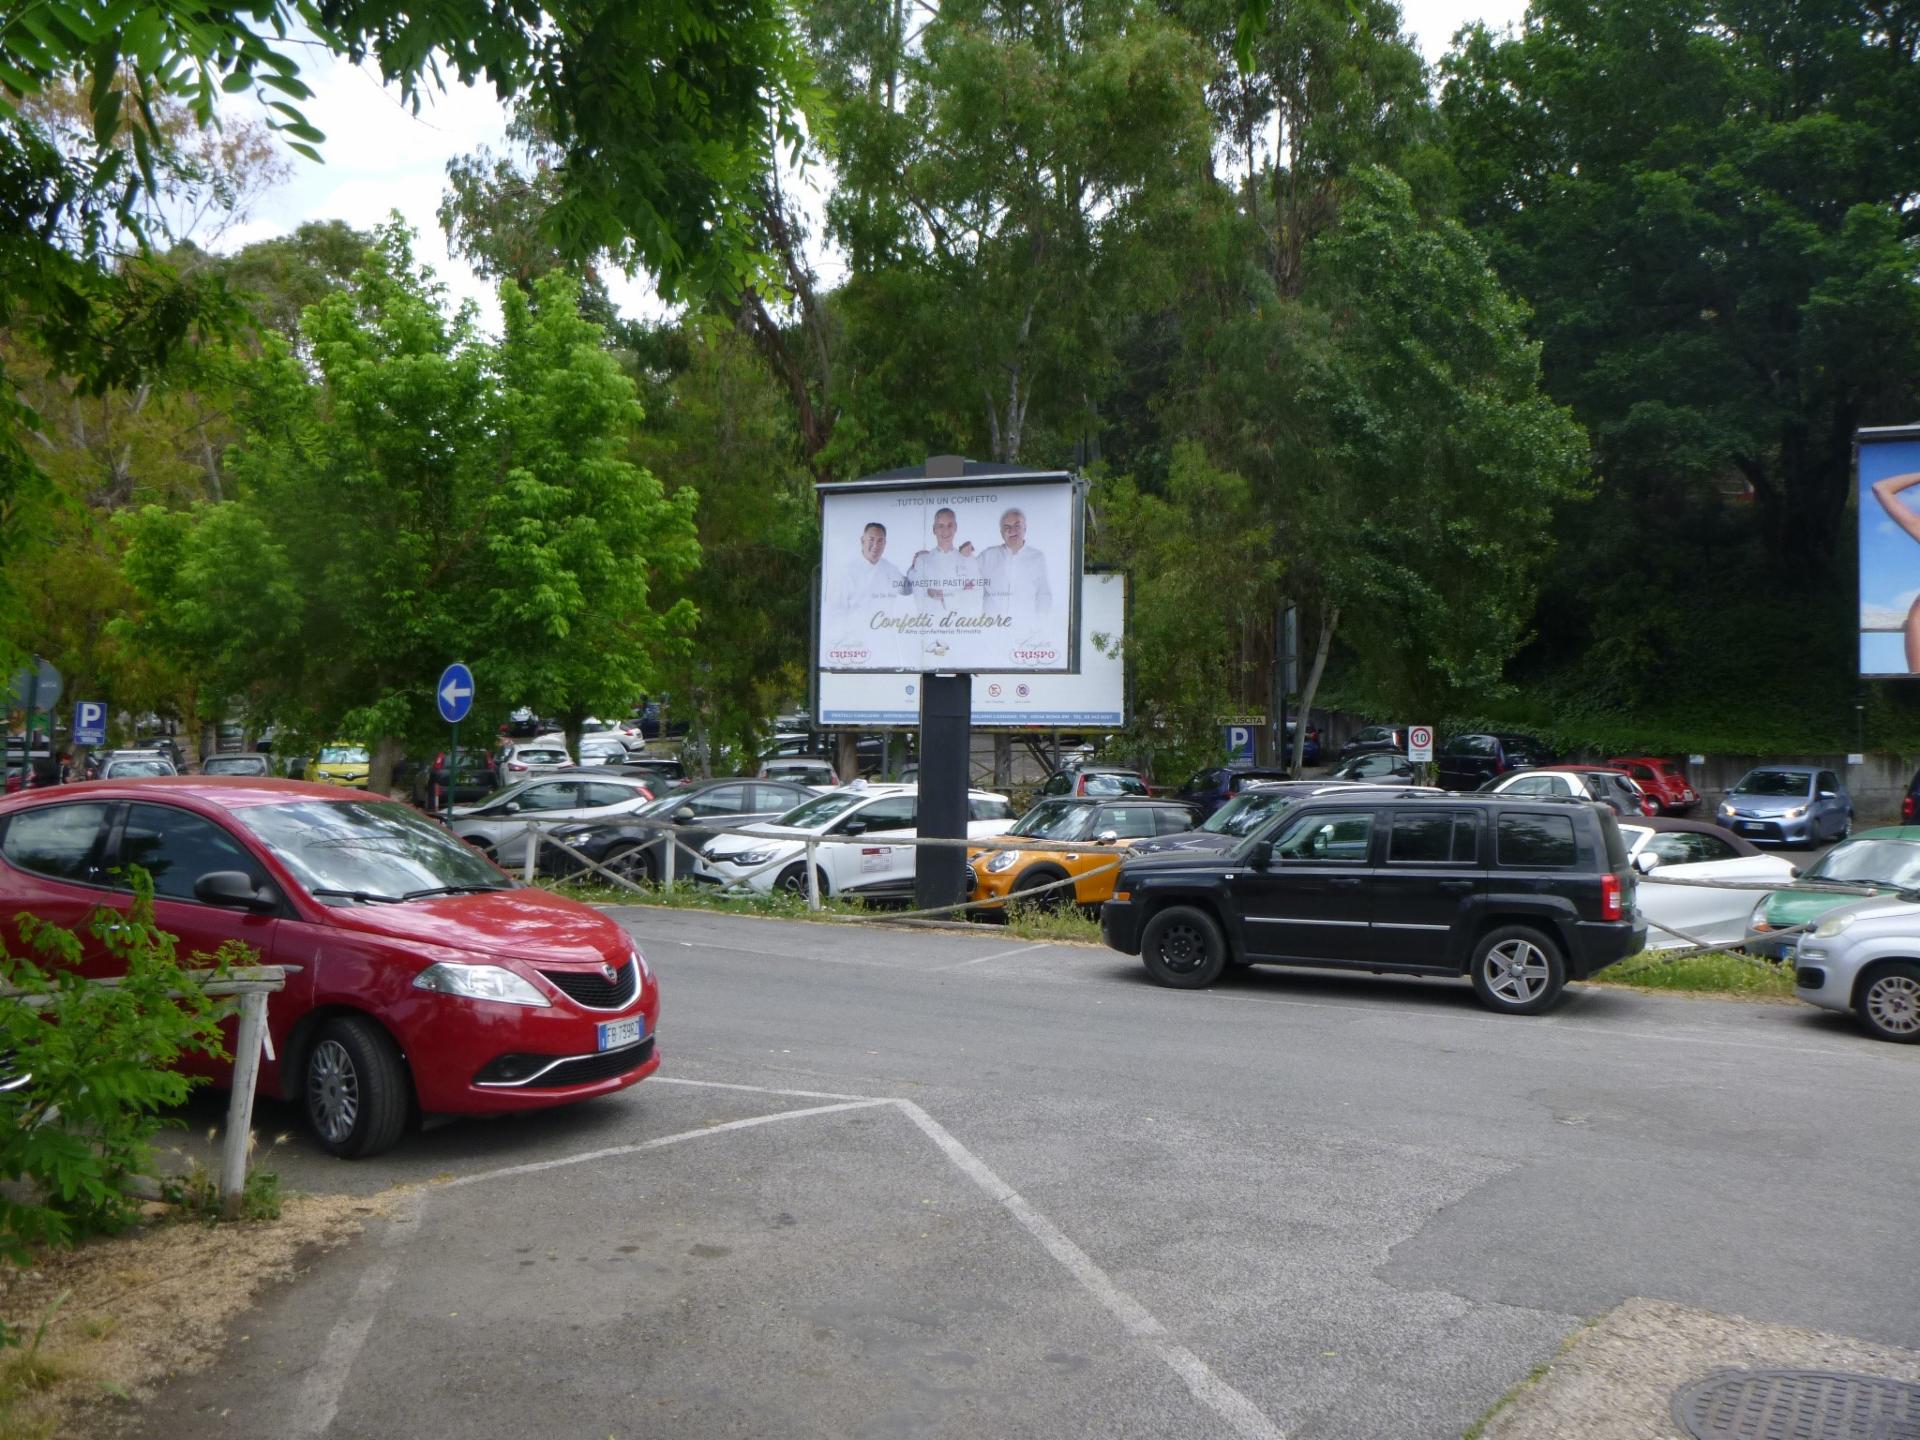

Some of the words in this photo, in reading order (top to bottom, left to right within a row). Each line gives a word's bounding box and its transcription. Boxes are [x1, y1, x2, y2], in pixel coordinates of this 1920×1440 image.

[926, 497, 934, 505] IN
[937, 497, 949, 505] UN
[951, 494, 998, 504] CONFETTO
[909, 579, 941, 588] MAESTRI
[870, 610, 933, 634] Confetti
[939, 610, 1012, 628] d'autore
[830, 650, 868, 659] CRISPO
[1013, 650, 1055, 660] CRISPO
[81, 703, 101, 728] P
[1231, 727, 1249, 750] P
[1415, 733, 1427, 743] 10
